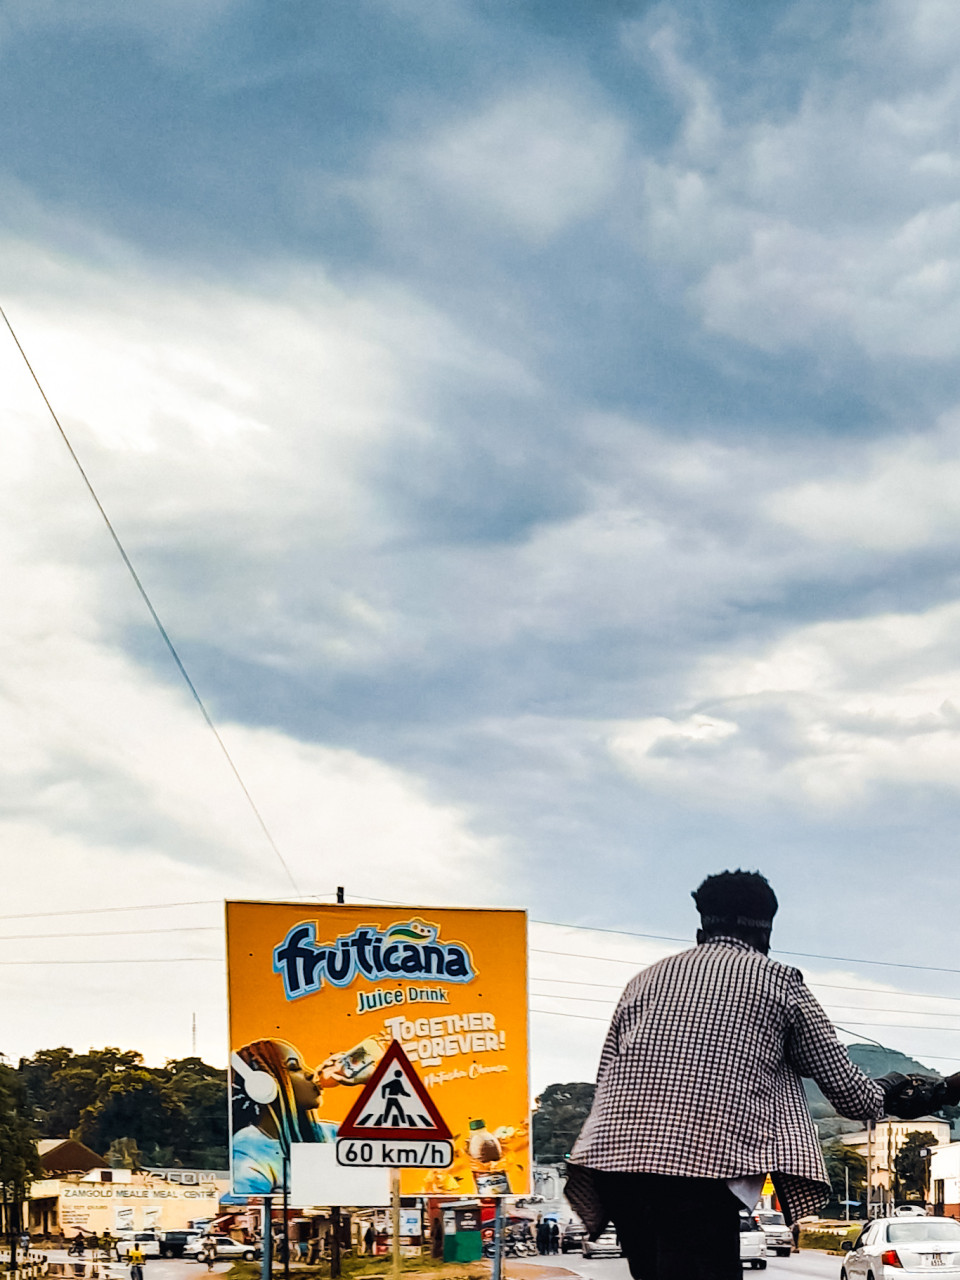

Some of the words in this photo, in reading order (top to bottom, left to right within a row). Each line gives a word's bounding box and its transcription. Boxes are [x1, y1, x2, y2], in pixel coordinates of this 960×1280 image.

[277, 926, 470, 993] fruticana
[357, 988, 404, 1013] Juice
[408, 986, 449, 1003] Drink
[384, 1012, 496, 1041] TOGETHER
[345, 1142, 373, 1163] 60
[382, 1142, 445, 1164] km/h
